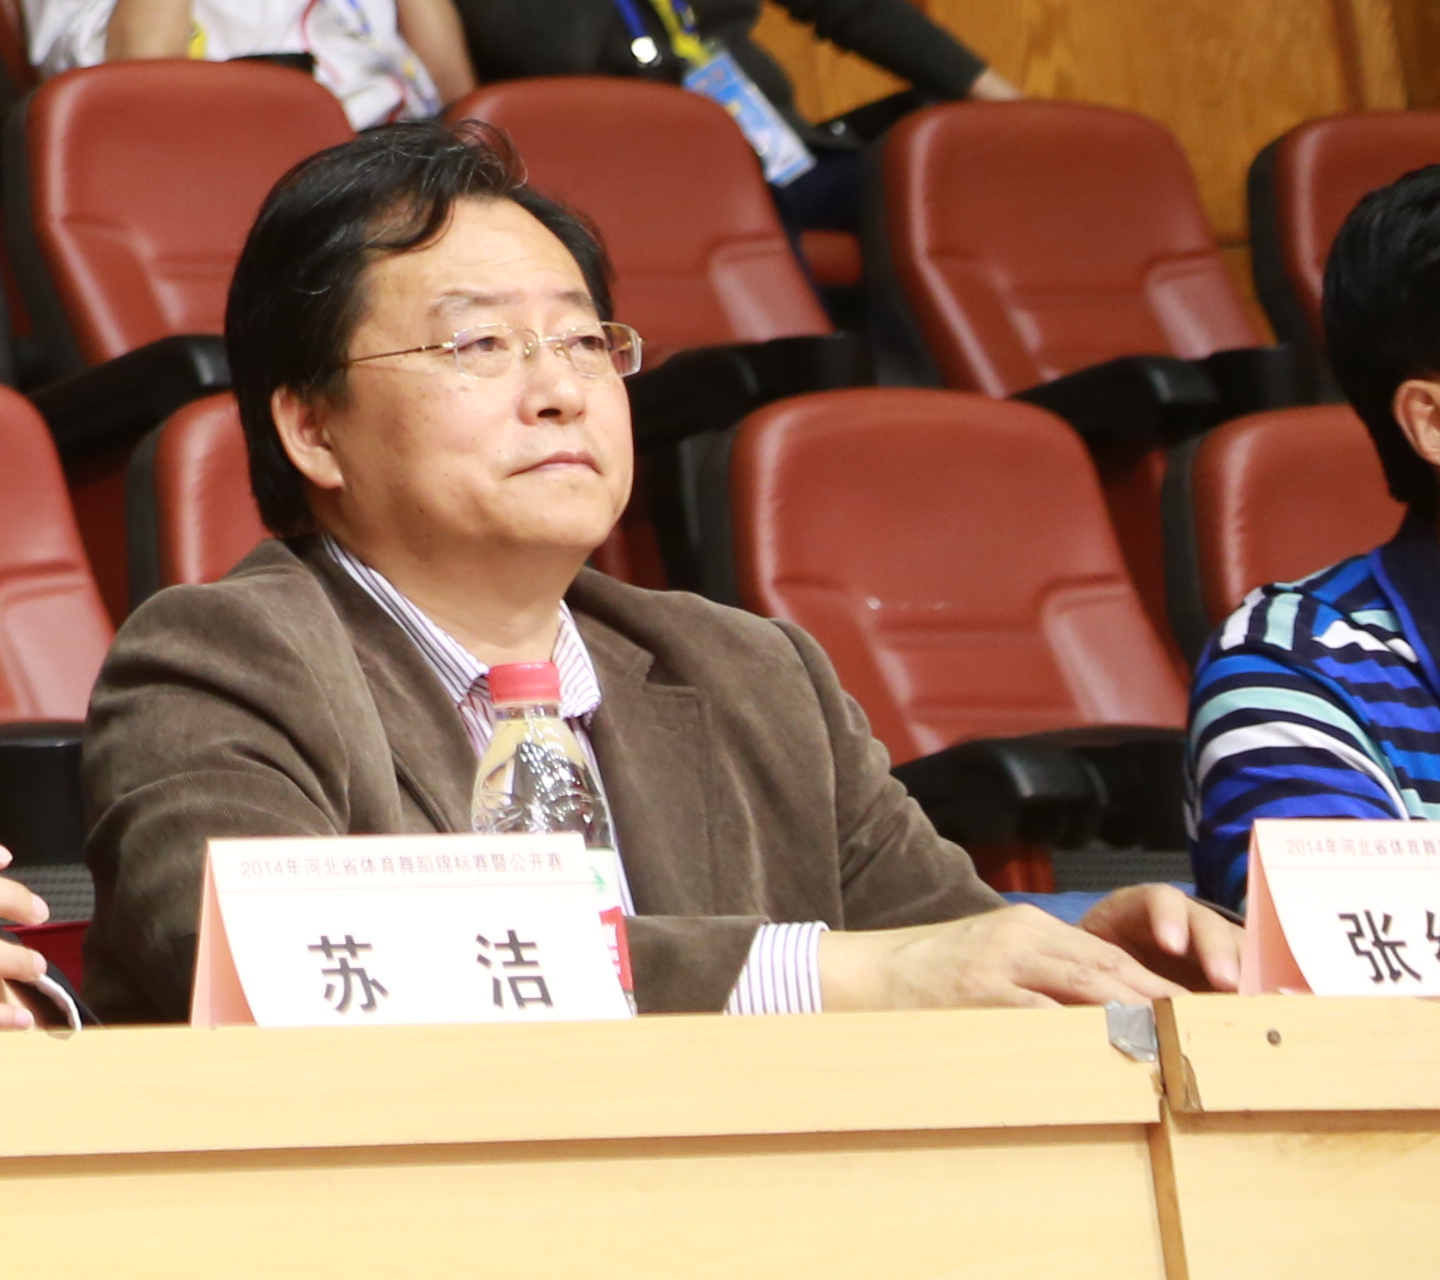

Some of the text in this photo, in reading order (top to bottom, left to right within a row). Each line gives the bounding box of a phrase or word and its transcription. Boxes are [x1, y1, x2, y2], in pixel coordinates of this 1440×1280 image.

[240, 850, 564, 879] 2014年河北省体育舞蹈锦标赛暨公开赛
